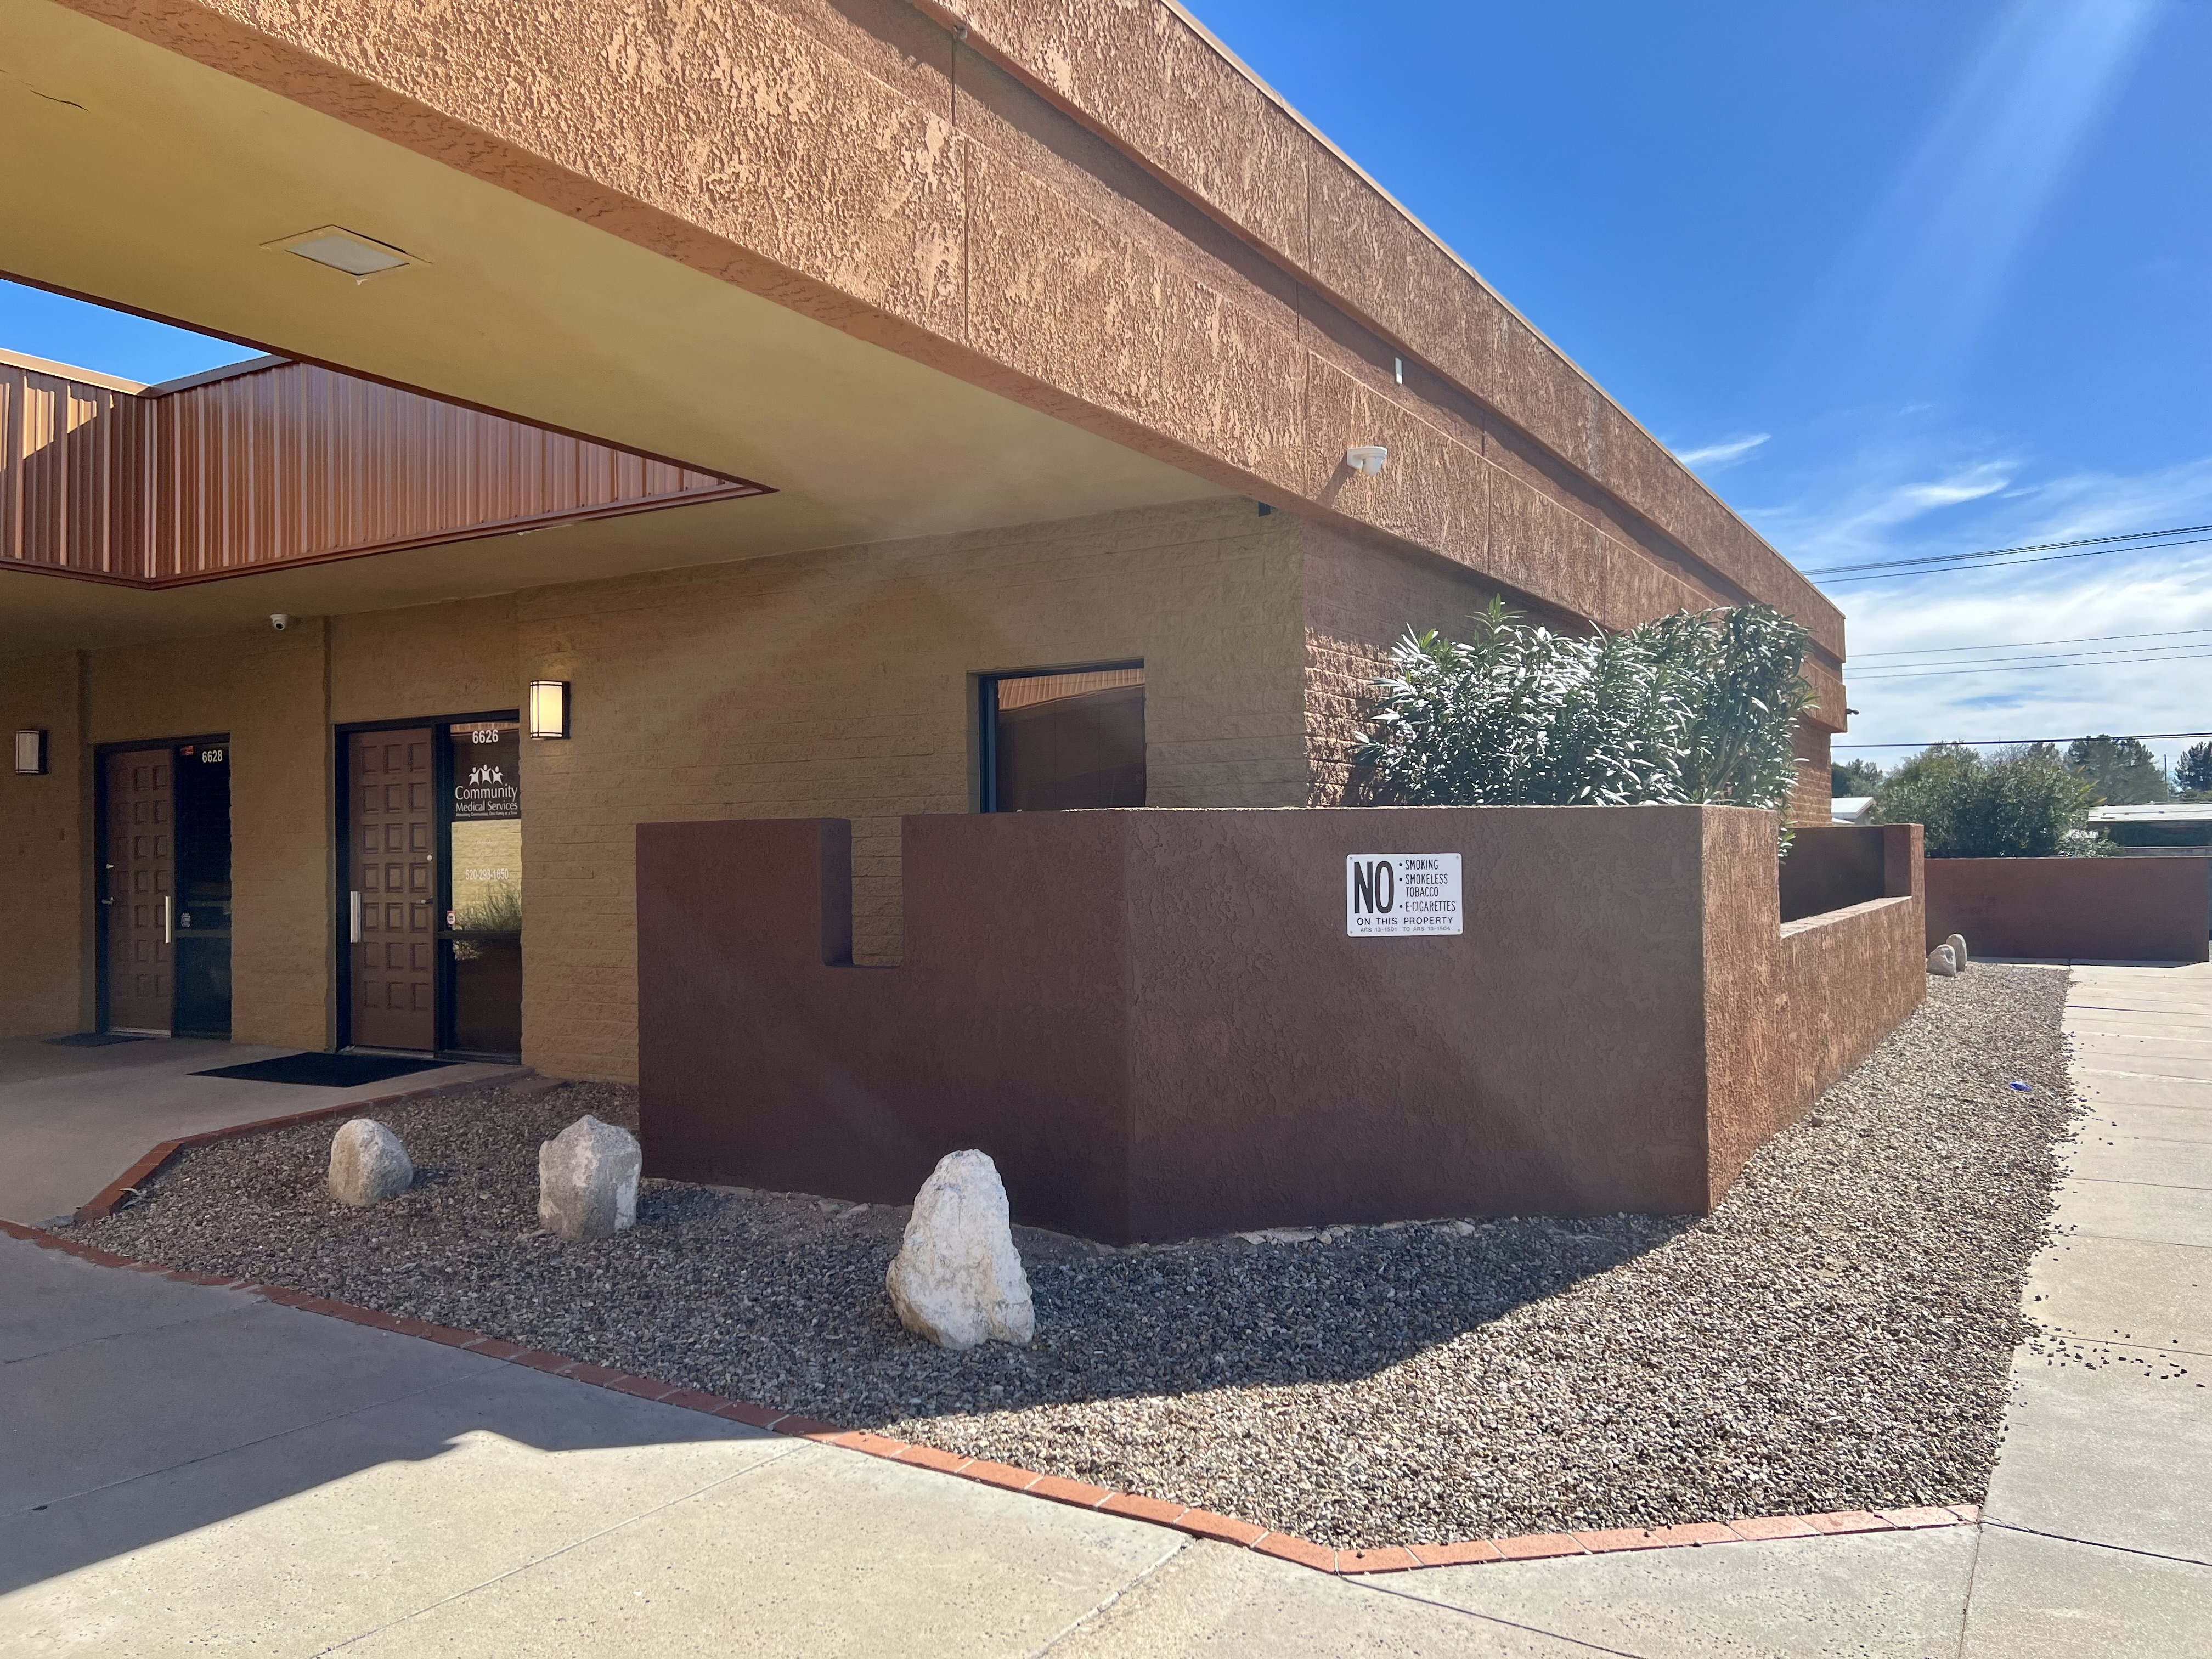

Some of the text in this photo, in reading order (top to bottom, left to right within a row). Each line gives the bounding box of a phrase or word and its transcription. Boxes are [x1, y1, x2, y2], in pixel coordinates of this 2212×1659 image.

[472, 729, 499, 744] 6626
[202, 749, 223, 763] 6628
[455, 783, 518, 802] Community
[455, 800, 518, 812] Medical Services
[1405, 859, 1438, 870] SMOKING
[465, 868, 509, 881] 520-298-1650
[1405, 873, 1448, 884] SMOKELESS
[1354, 861, 1394, 913] NO
[1406, 887, 1438, 898] TOBACCO
